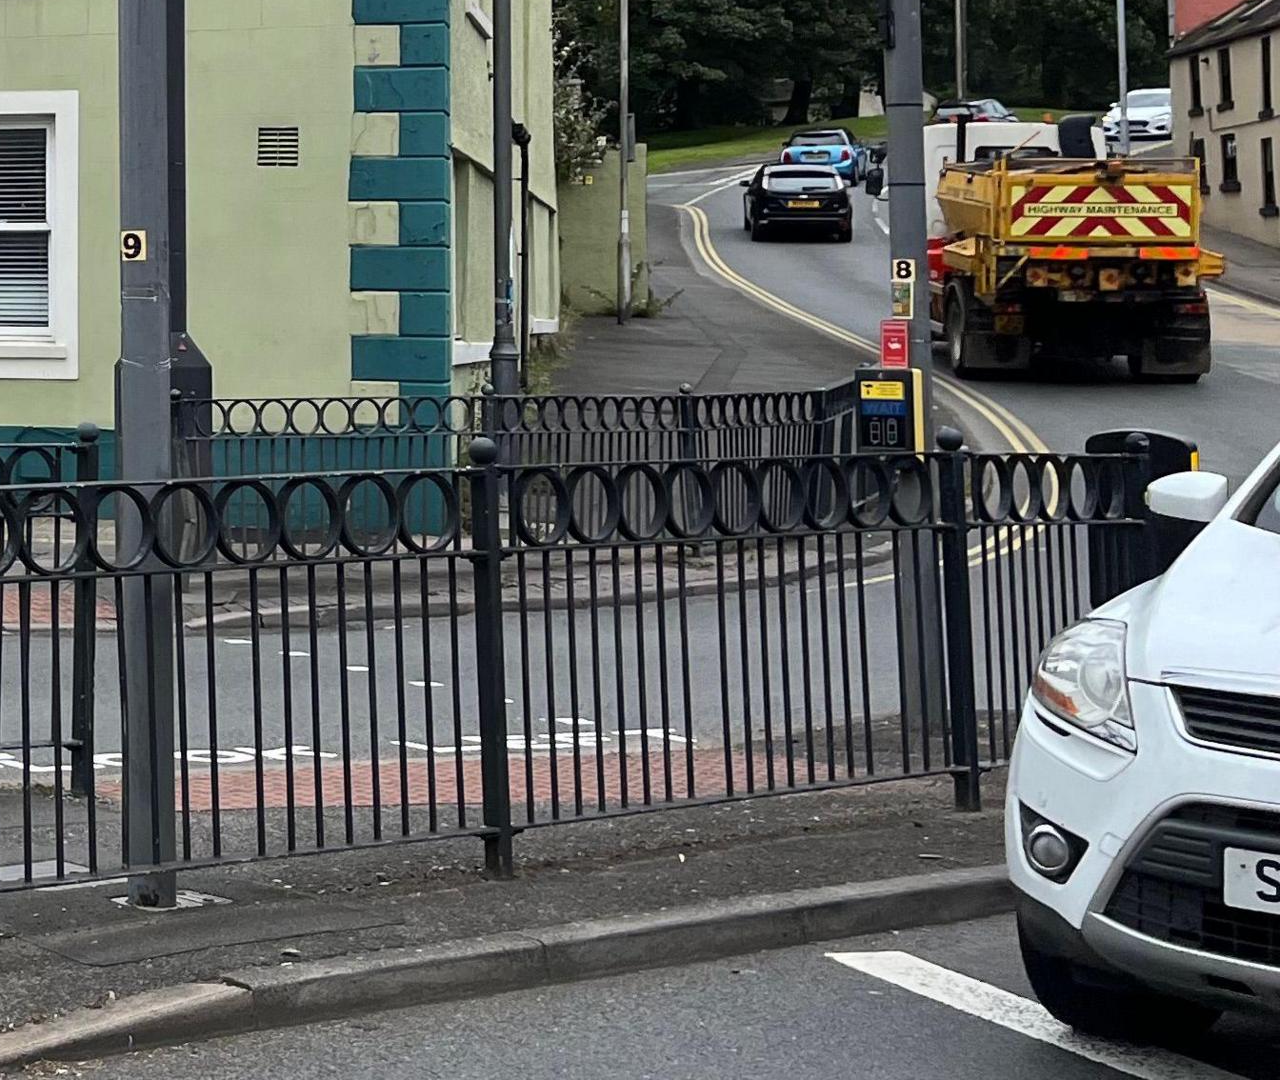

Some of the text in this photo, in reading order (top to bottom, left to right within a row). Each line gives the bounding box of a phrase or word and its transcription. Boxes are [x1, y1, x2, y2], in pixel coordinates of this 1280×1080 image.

[1027, 205, 1174, 215] HIGHWAY MAINTENANCE
[123, 233, 142, 260] 9
[896, 260, 912, 279] 8
